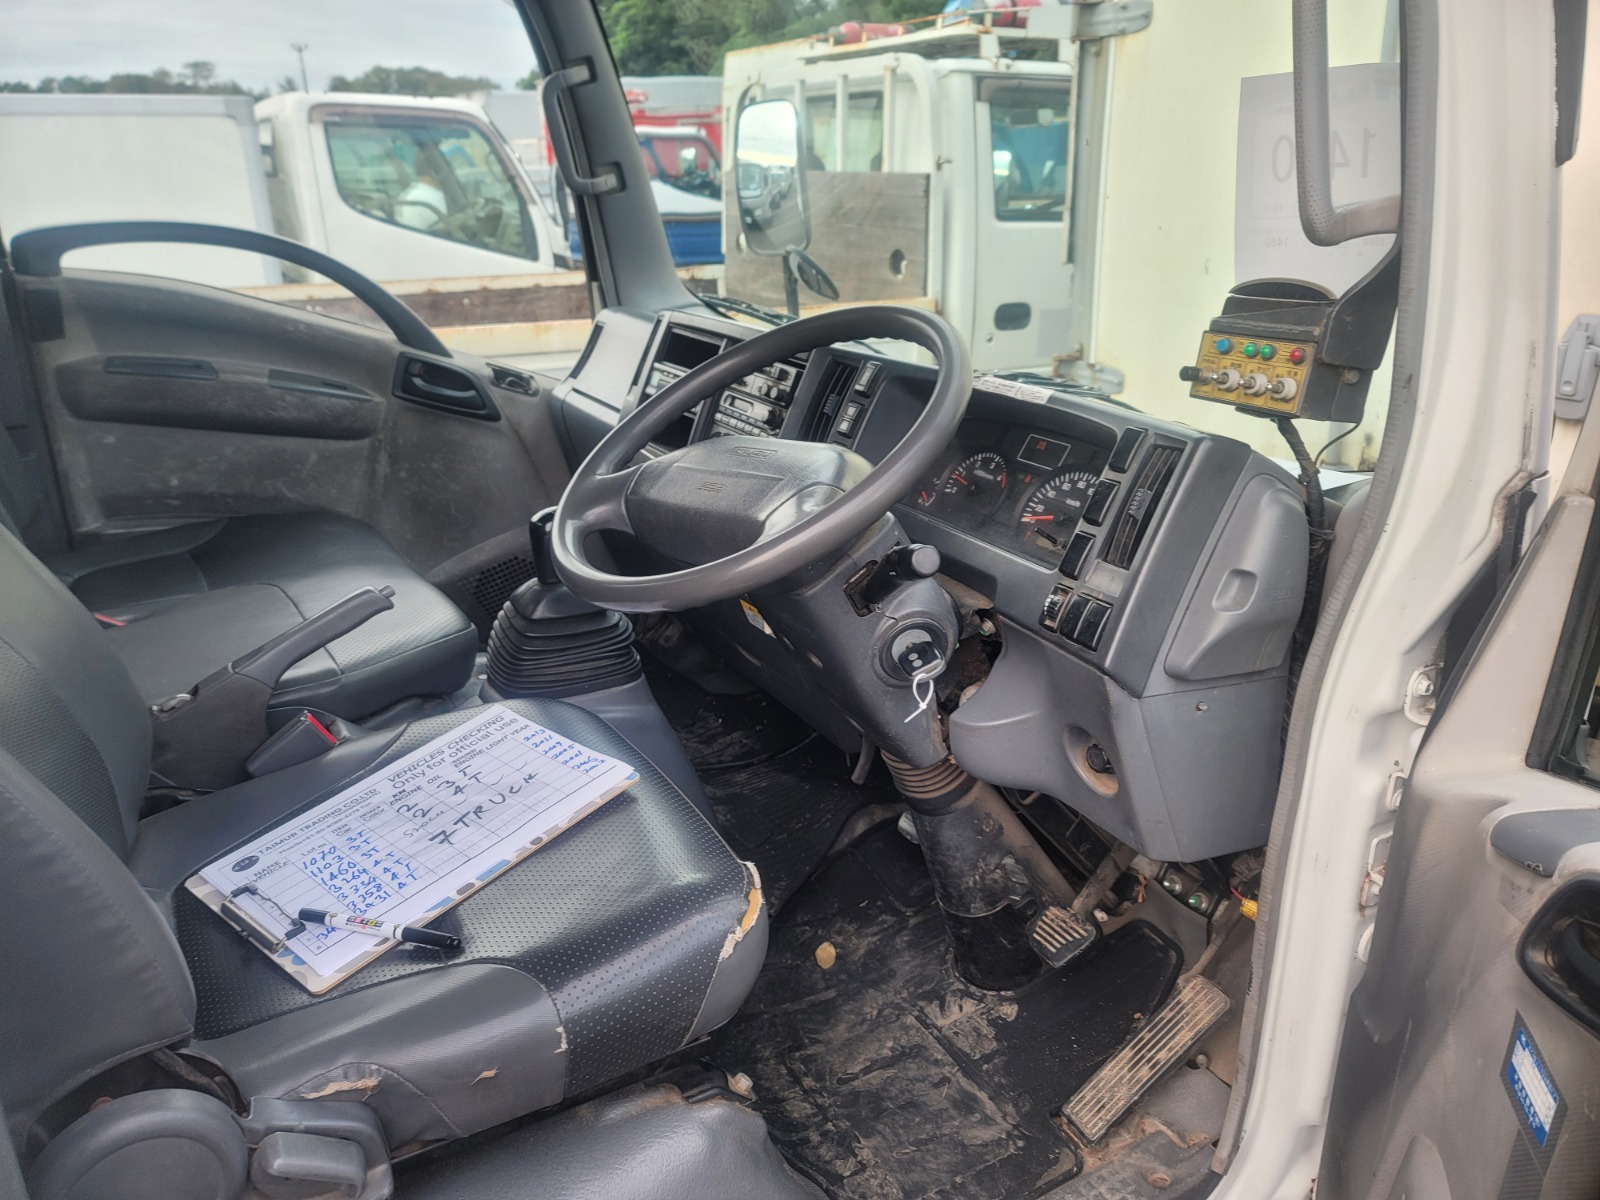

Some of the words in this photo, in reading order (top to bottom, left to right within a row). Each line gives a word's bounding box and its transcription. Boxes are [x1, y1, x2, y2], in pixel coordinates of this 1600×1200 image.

[388, 748, 445, 783] VEHICLES
[447, 715, 505, 750] CHECKING
[392, 769, 426, 789] Only
[426, 756, 447, 771] for
[449, 730, 495, 758] official
[494, 717, 519, 732] use
[452, 748, 477, 764] SOUND
[454, 749, 485, 768] ENGINE
[485, 734, 509, 751] LIGHT
[509, 724, 531, 736] YEAR
[389, 784, 424, 807] ENGINE
[426, 773, 443, 785] OIL
[453, 772, 540, 828] TRUCK
[363, 808, 385, 822] Color
[257, 831, 298, 855] TAIMUR
[299, 806, 343, 832] TRADING
[336, 827, 352, 837] Car
[253, 860, 281, 877] NAME
[303, 846, 336, 870] 1070
[310, 855, 344, 877] 1103
[252, 861, 289, 883] VEHICLE
[321, 861, 357, 887] 1460
[346, 882, 383, 911] 3358
